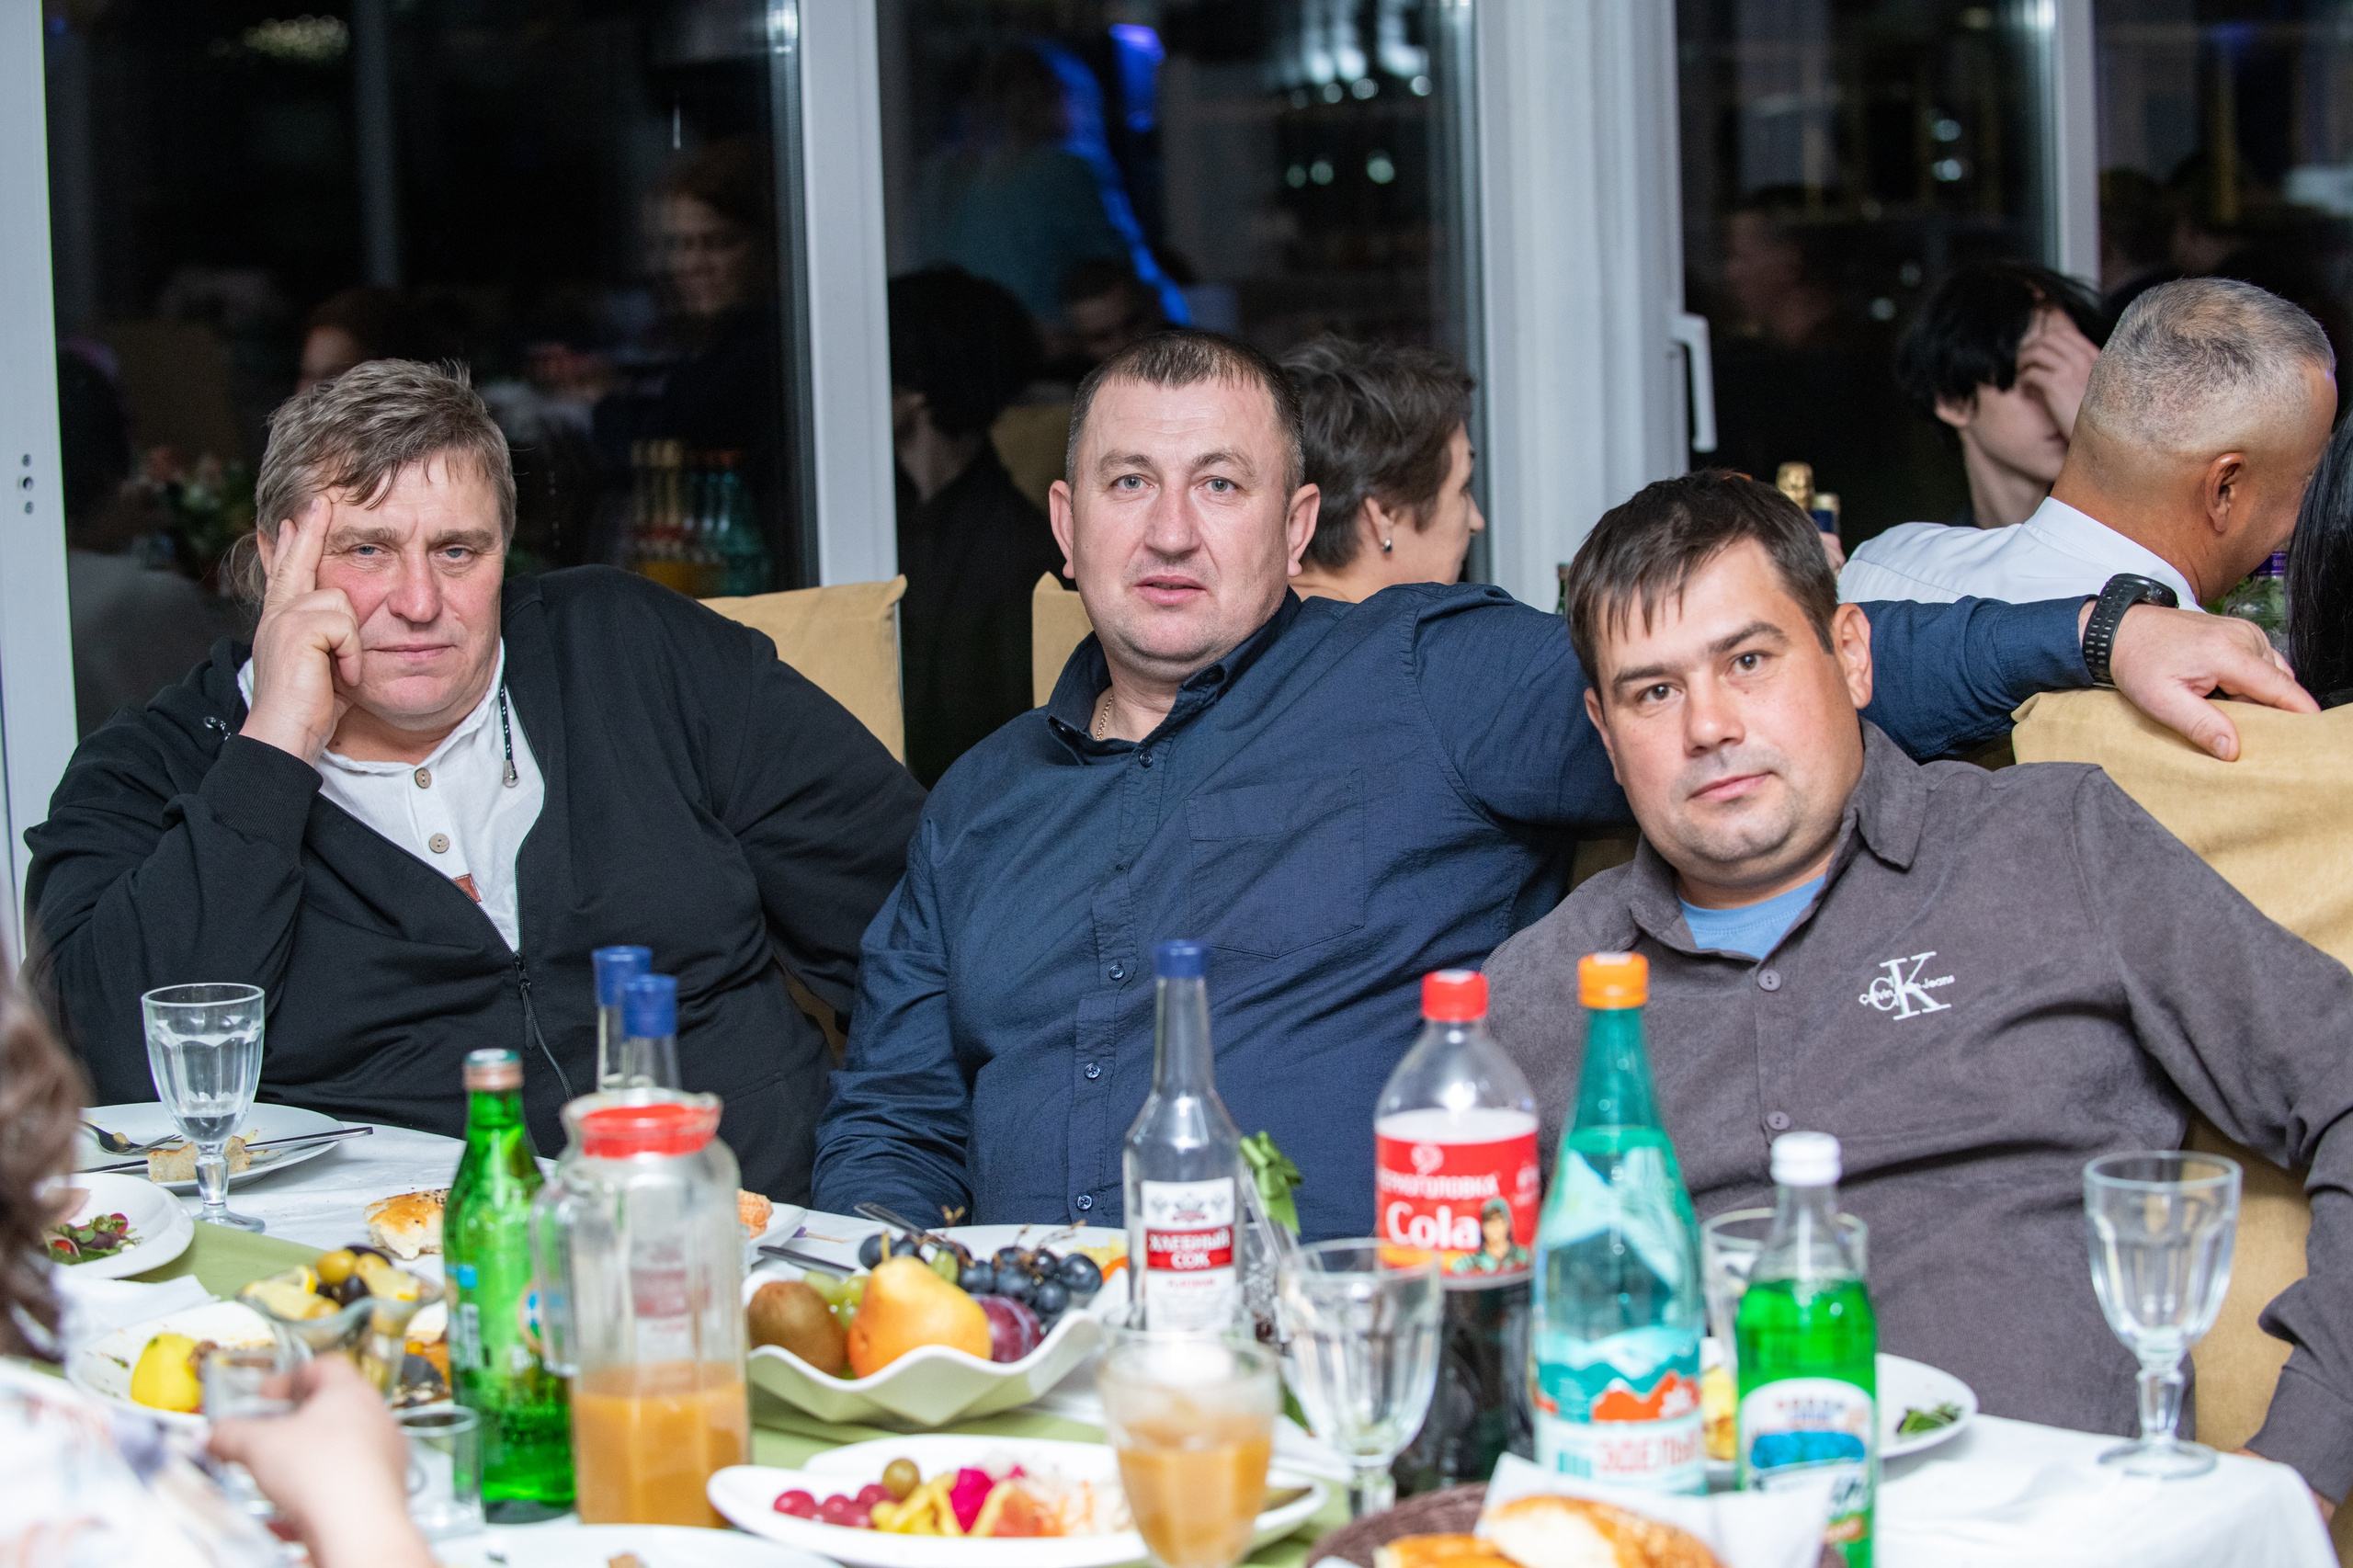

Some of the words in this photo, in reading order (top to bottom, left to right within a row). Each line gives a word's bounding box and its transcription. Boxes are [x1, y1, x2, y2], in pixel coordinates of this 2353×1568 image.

[1386, 1200, 1481, 1249] Cola
[1149, 1227, 1231, 1252] ХЛЕБНЫЙ
[1171, 1251, 1211, 1269] СОК
